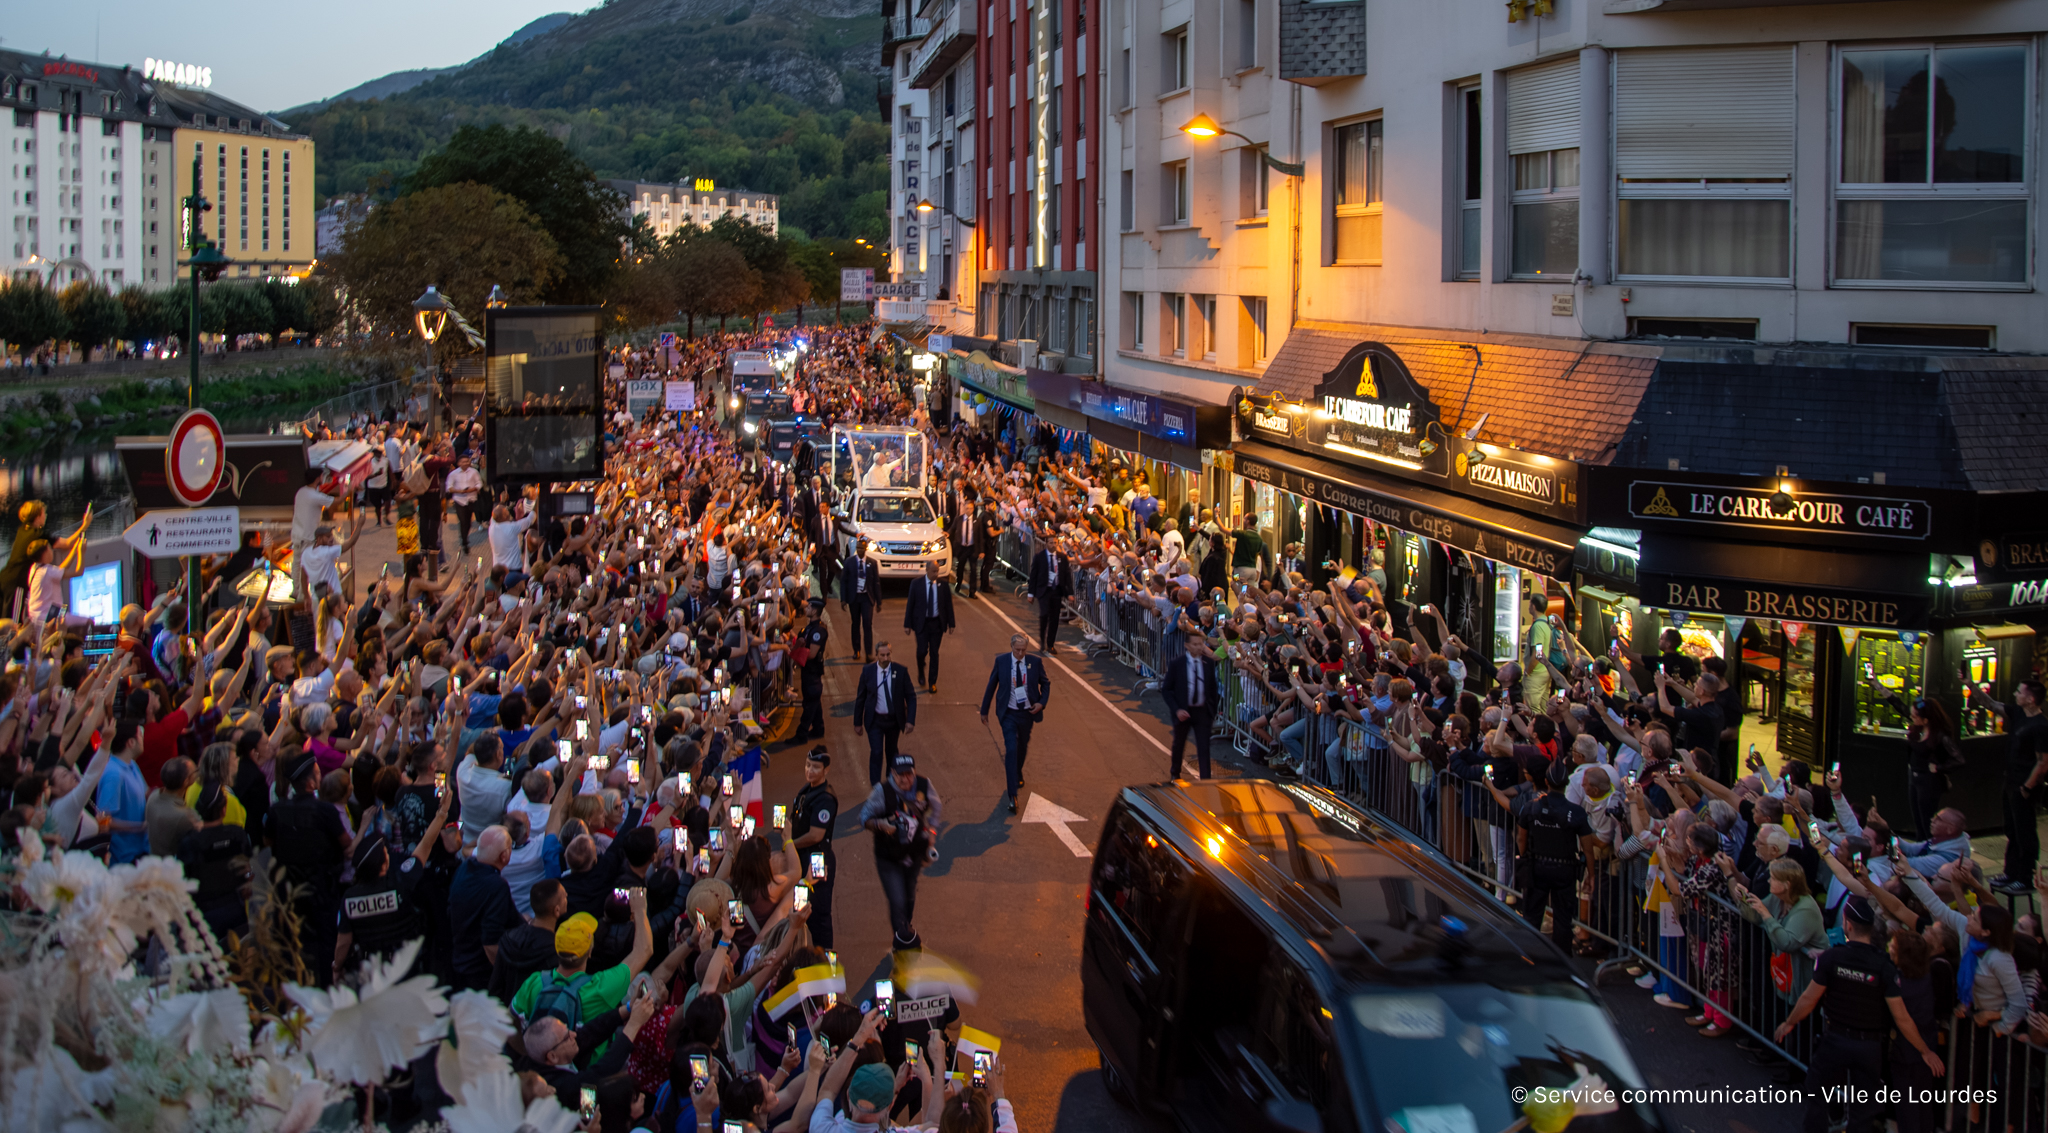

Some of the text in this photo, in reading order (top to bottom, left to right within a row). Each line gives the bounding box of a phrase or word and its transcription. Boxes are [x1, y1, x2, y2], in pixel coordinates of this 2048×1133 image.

[144, 57, 212, 88] PARADIS
[906, 121, 920, 255] ND de FRANCE
[875, 285, 918, 295] GARAGE
[631, 381, 657, 395] pax
[1133, 396, 1148, 425] CAFÉ
[1325, 396, 1411, 433] LE CARREFOUR CAFÉ
[1163, 413, 1184, 430] PIZZERIA
[1255, 412, 1288, 433] BRASSERIE
[1471, 463, 1551, 498] PIZZA MAISON
[165, 515, 232, 526] CENTRE-VILLE
[1690, 493, 1715, 515] LE
[1856, 503, 1914, 529] CAFÉ
[165, 527, 233, 538] RESTAURANTS
[1301, 477, 1315, 496] Le
[1322, 483, 1401, 523] Carrefour
[1409, 510, 1452, 538] Café
[1506, 541, 1555, 573] PIZZAS
[165, 539, 231, 550] COMMERCES
[2010, 544, 2048, 565] BRA
[1667, 583, 1722, 610] BAR
[1745, 590, 1899, 626] BRASSERIE
[349, 894, 394, 916] POLICE
[1838, 967, 1865, 979] POLICE
[901, 997, 946, 1013] POLICE
[901, 1008, 945, 1020] NATIONAL
